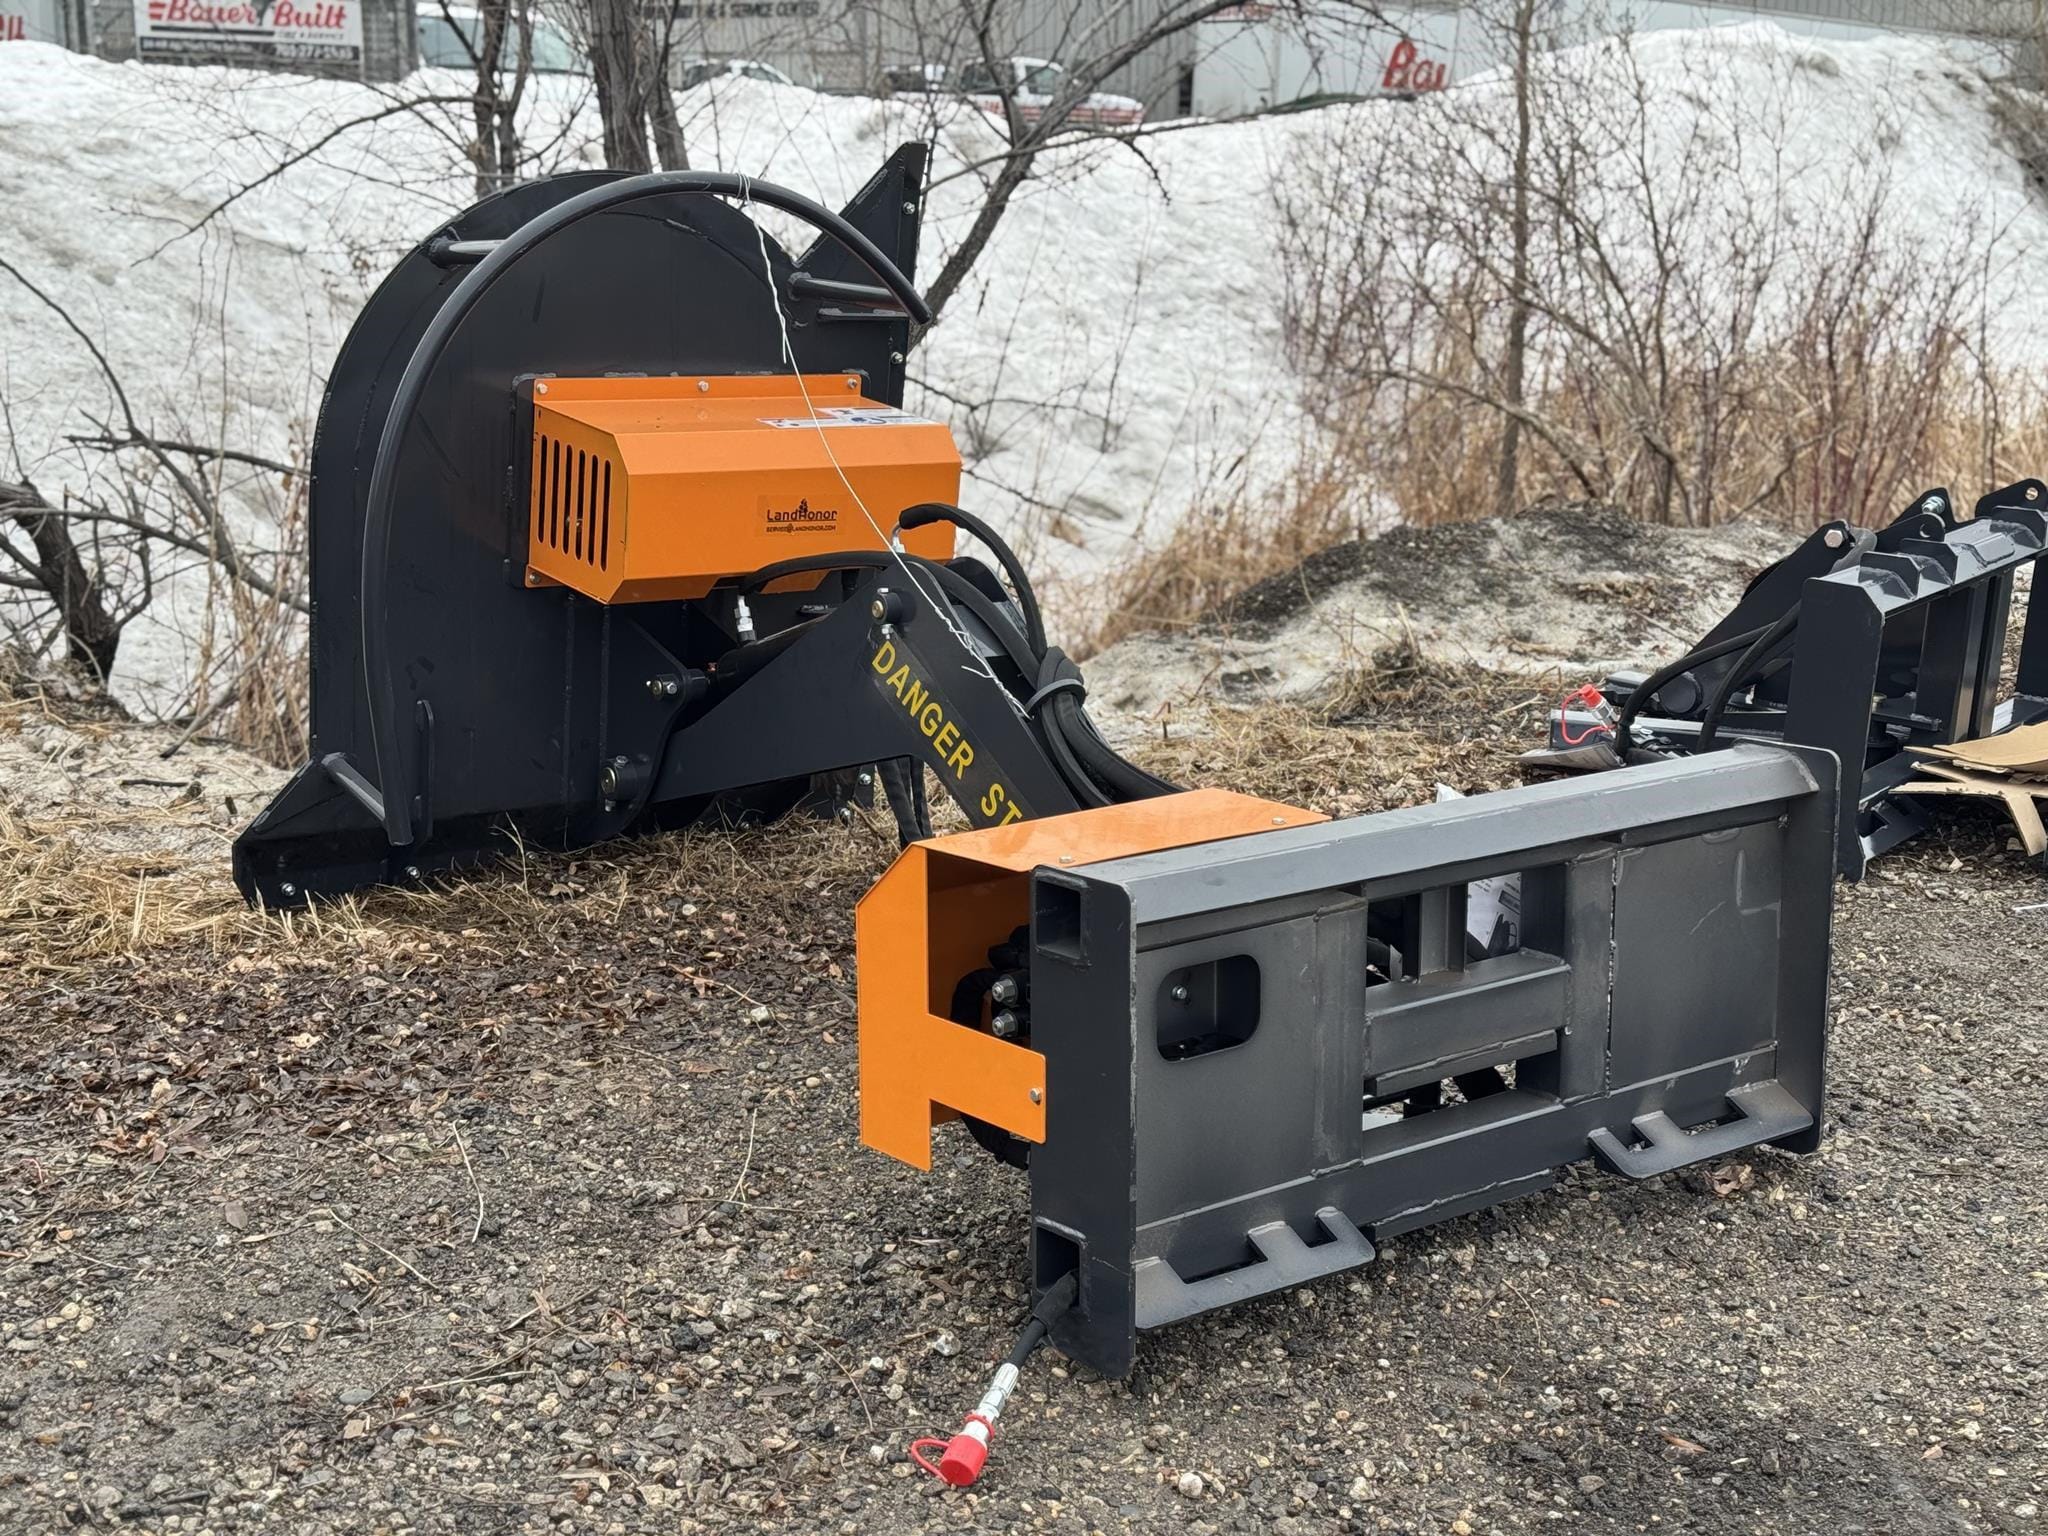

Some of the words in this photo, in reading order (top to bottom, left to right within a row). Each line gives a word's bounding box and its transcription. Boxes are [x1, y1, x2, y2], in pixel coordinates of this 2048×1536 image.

[166, 0, 256, 24] Bauer
[273, 1, 347, 28] Built
[767, 509, 838, 522] LandHonor
[872, 641, 974, 780] DANGER
